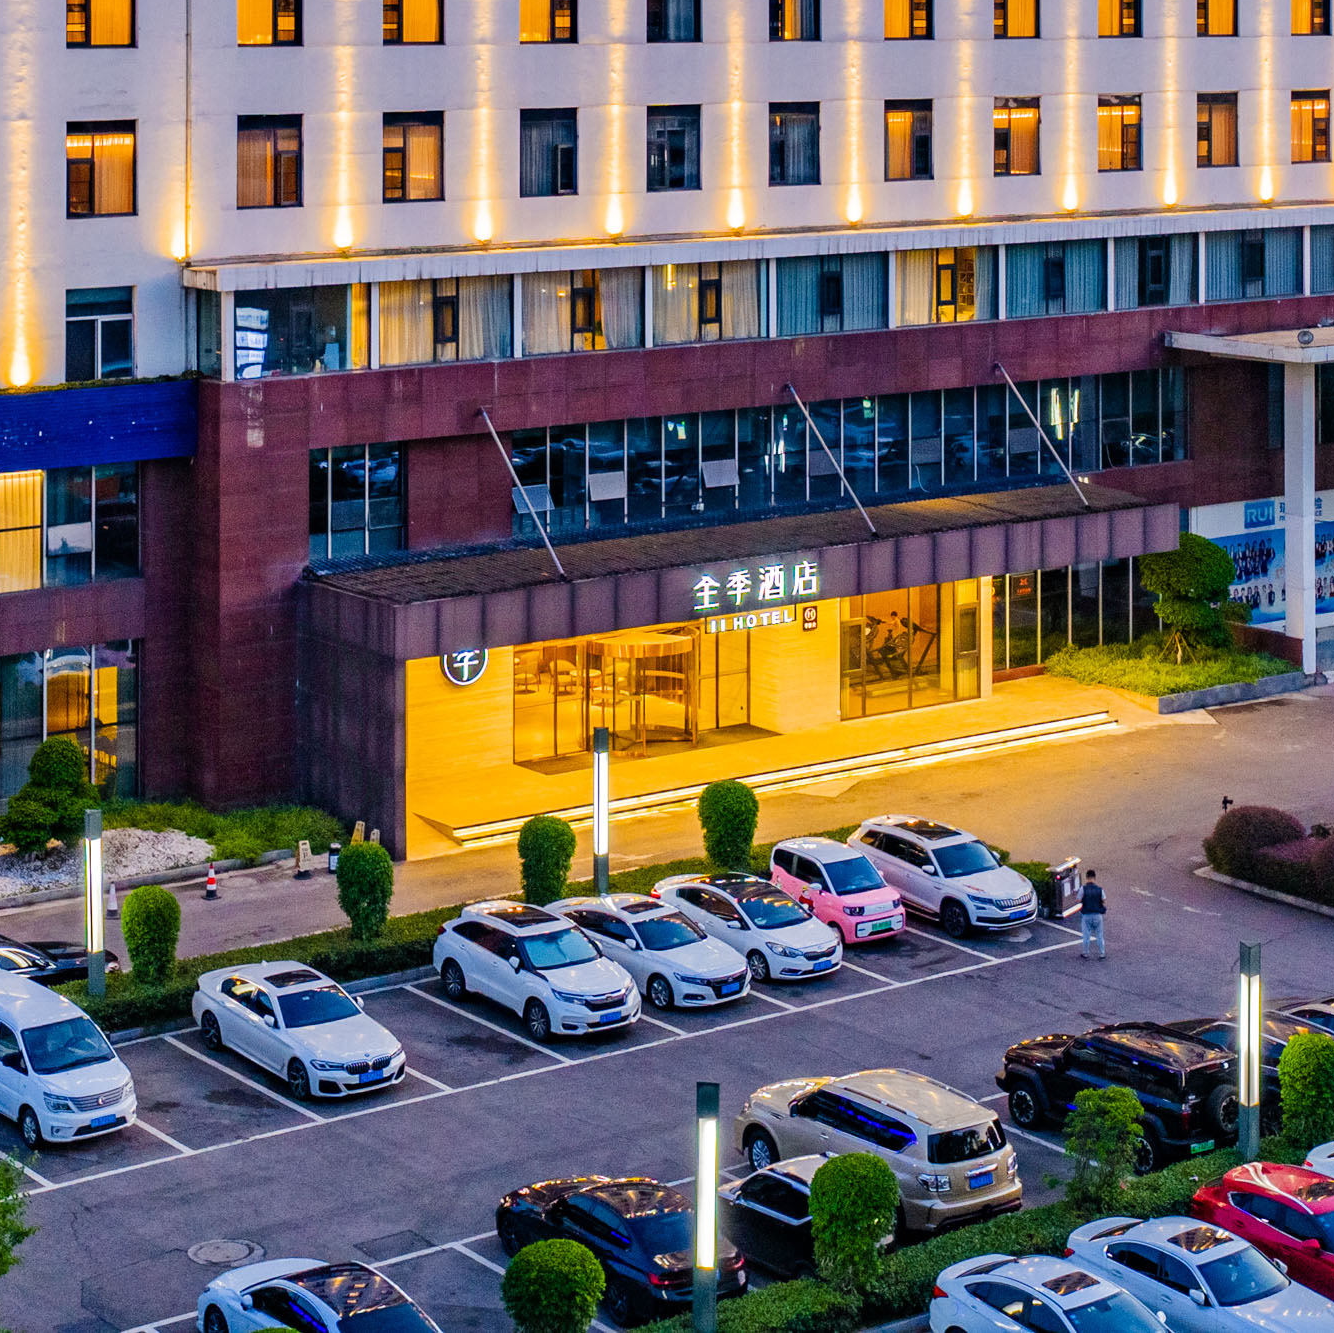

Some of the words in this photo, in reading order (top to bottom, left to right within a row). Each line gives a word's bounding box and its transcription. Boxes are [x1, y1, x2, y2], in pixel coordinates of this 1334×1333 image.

[693, 561, 818, 610] 全季酒店
[733, 610, 793, 631] HOTEL
